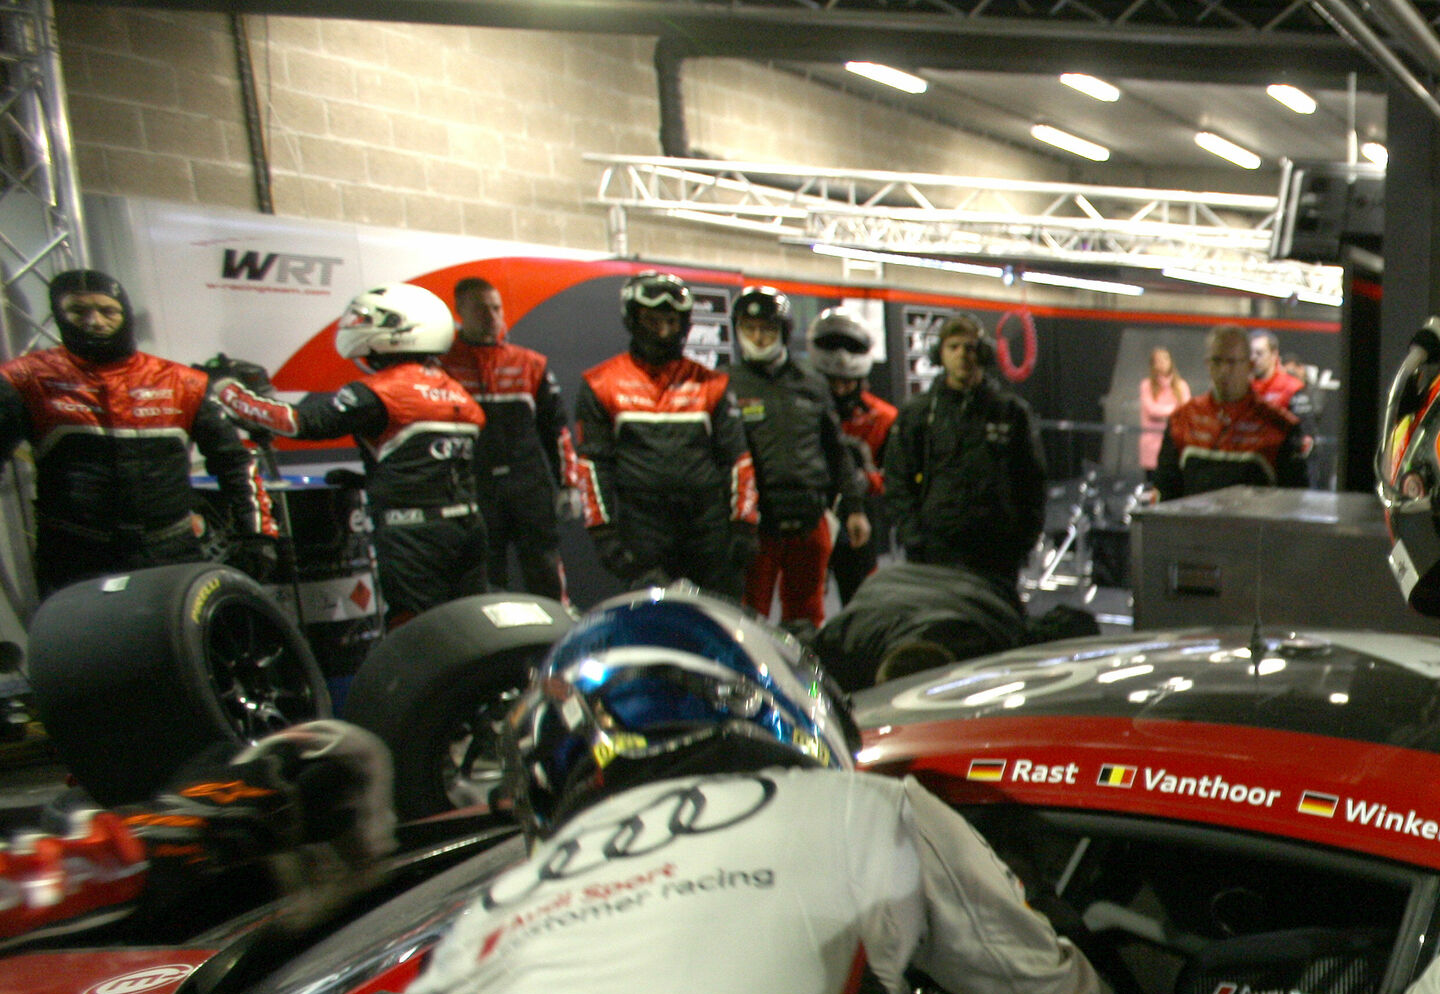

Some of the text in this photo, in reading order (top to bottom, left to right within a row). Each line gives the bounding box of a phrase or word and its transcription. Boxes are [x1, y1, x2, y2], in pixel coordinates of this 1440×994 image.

[222, 249, 344, 286] WRT
[413, 383, 468, 404] TOTAL
[1011, 759, 1079, 787] Rast
[1143, 767, 1281, 809] Vanthoor
[582, 862, 675, 900] Sport
[661, 866, 775, 898] racing
